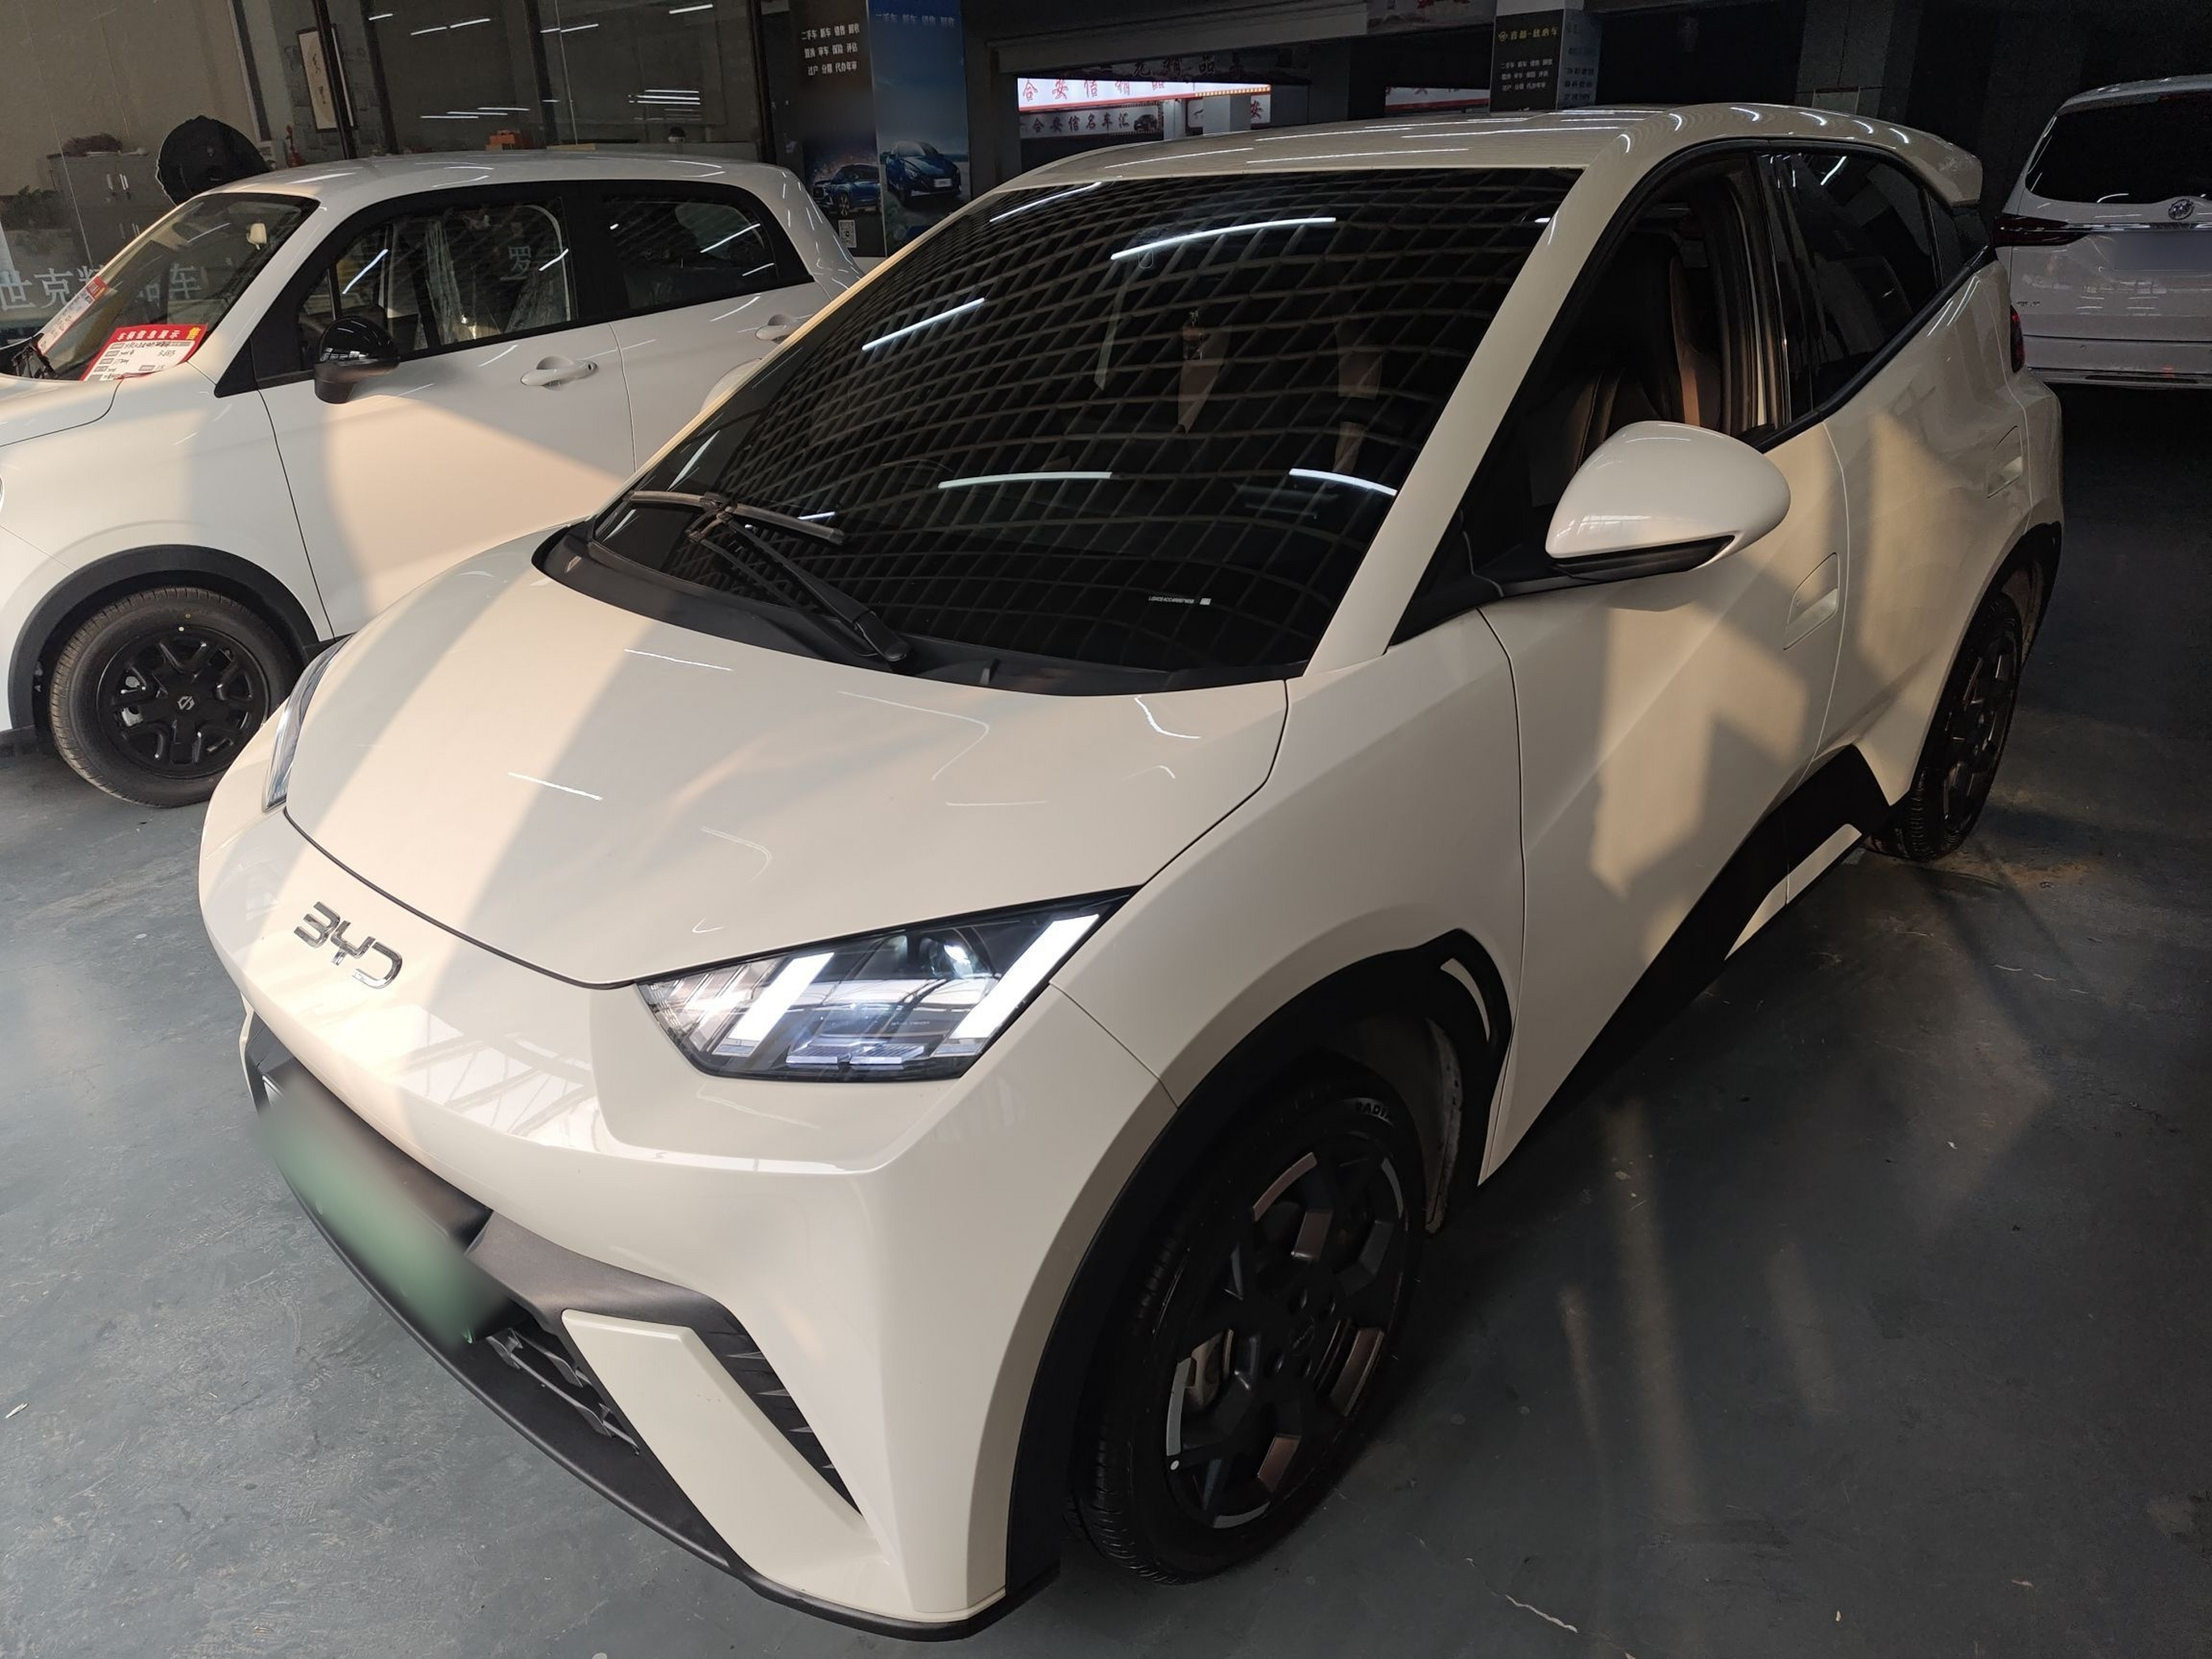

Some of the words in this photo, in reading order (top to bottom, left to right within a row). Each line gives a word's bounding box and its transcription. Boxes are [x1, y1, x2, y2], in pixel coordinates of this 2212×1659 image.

[876, 13, 897, 23] 二手车
[801, 29, 817, 40] 二手车
[820, 27, 831, 38] 新车
[294, 901, 403, 990] BYD
